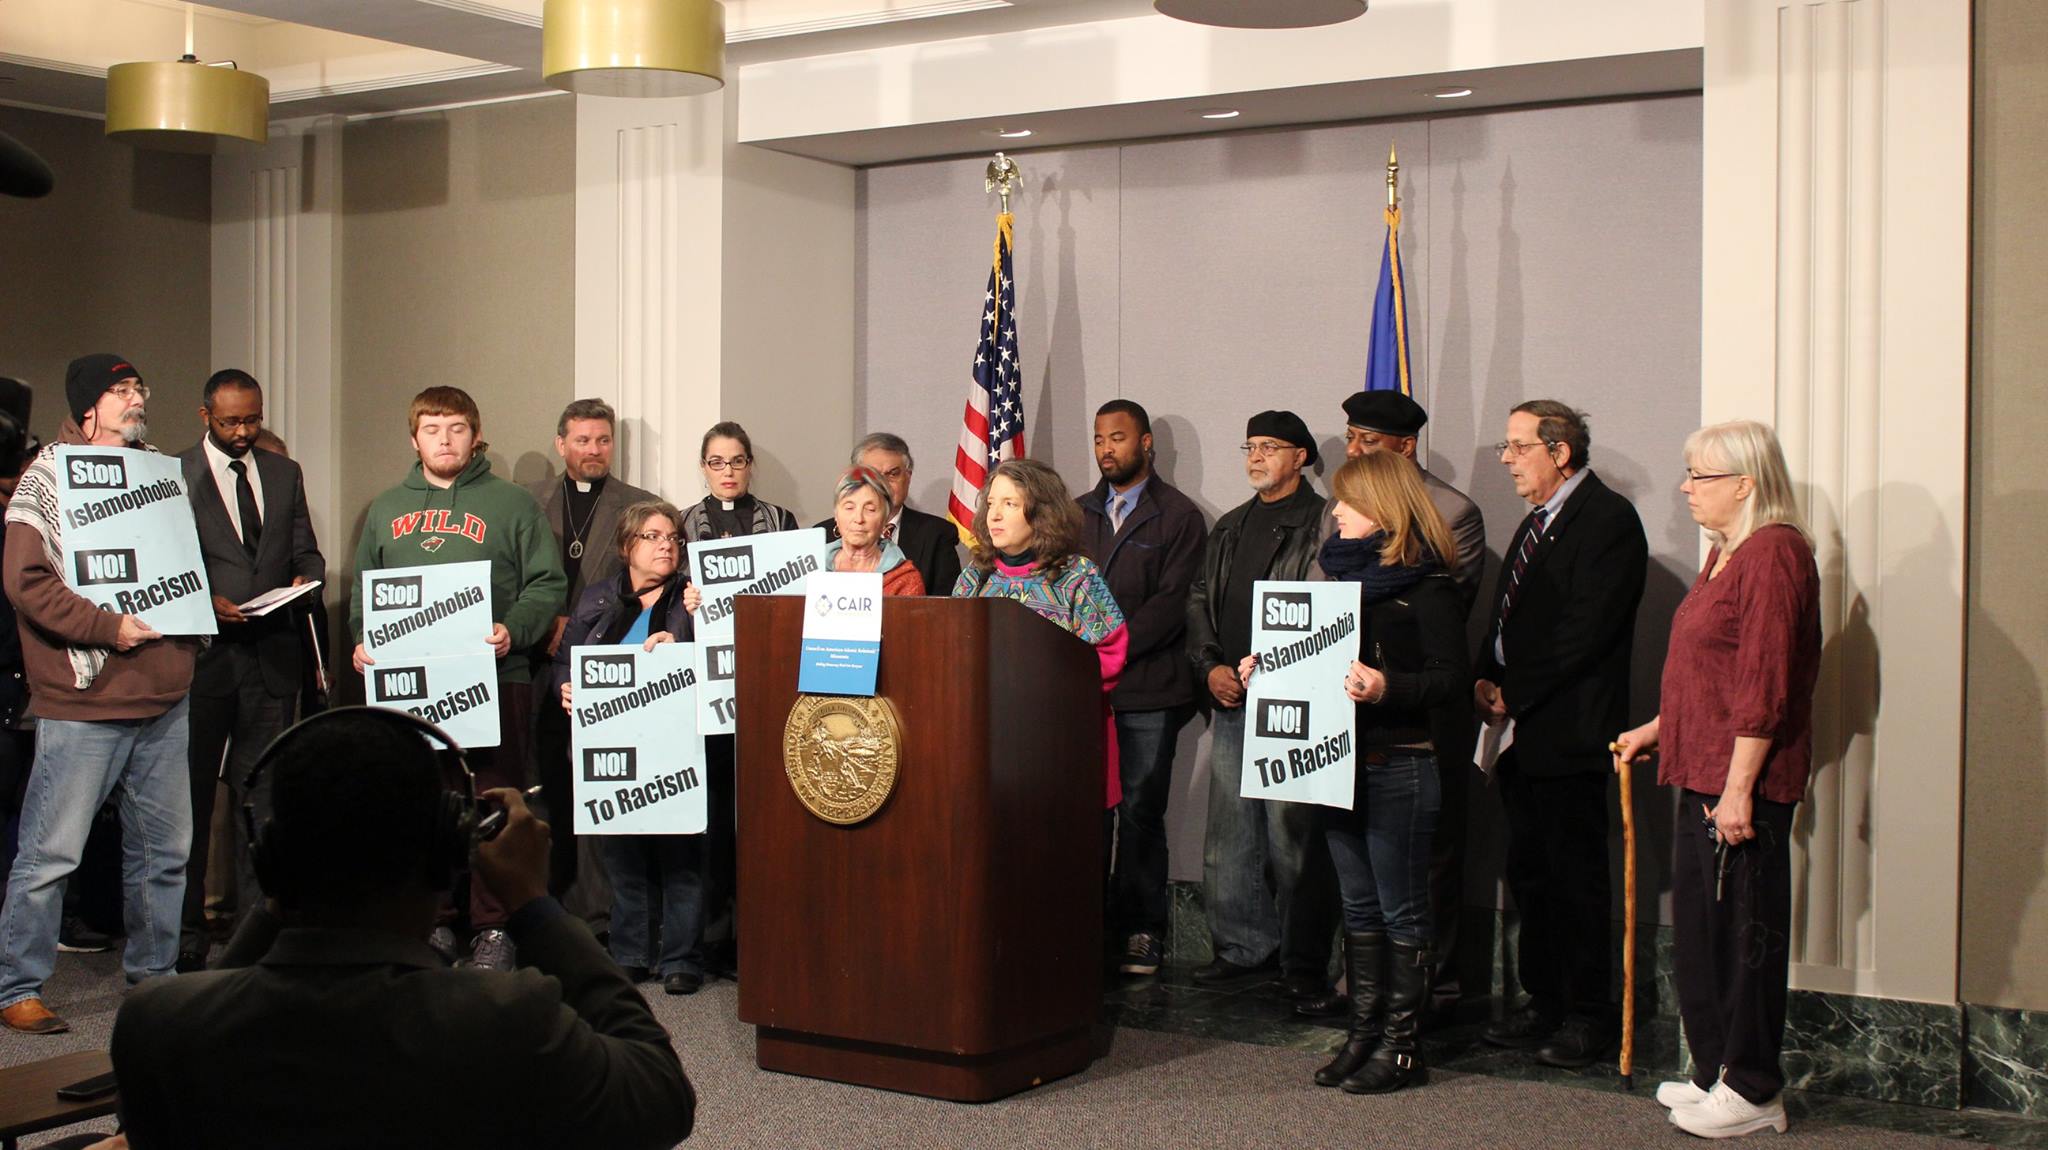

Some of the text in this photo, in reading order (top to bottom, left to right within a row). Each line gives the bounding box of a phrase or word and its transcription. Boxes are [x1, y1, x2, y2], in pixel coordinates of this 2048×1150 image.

[71, 459, 123, 486] Stop
[64, 478, 182, 530] Islamophobia
[391, 509, 487, 544] WILD
[87, 553, 126, 580] NO!
[703, 553, 751, 580] Stop
[115, 569, 203, 615] Racism
[375, 582, 419, 607] Stop
[837, 596, 872, 612] CAIR
[367, 585, 485, 650] Islamophobia
[1265, 597, 1310, 629] Stop
[1256, 611, 1355, 675] Islamophobia
[384, 671, 417, 697] NO!
[584, 659, 632, 686] Stop
[576, 667, 697, 728] Islamophobia
[1267, 704, 1302, 734] NO!
[593, 752, 628, 777] NO!
[1254, 729, 1352, 788] To Racism
[584, 766, 700, 826] To Racism
